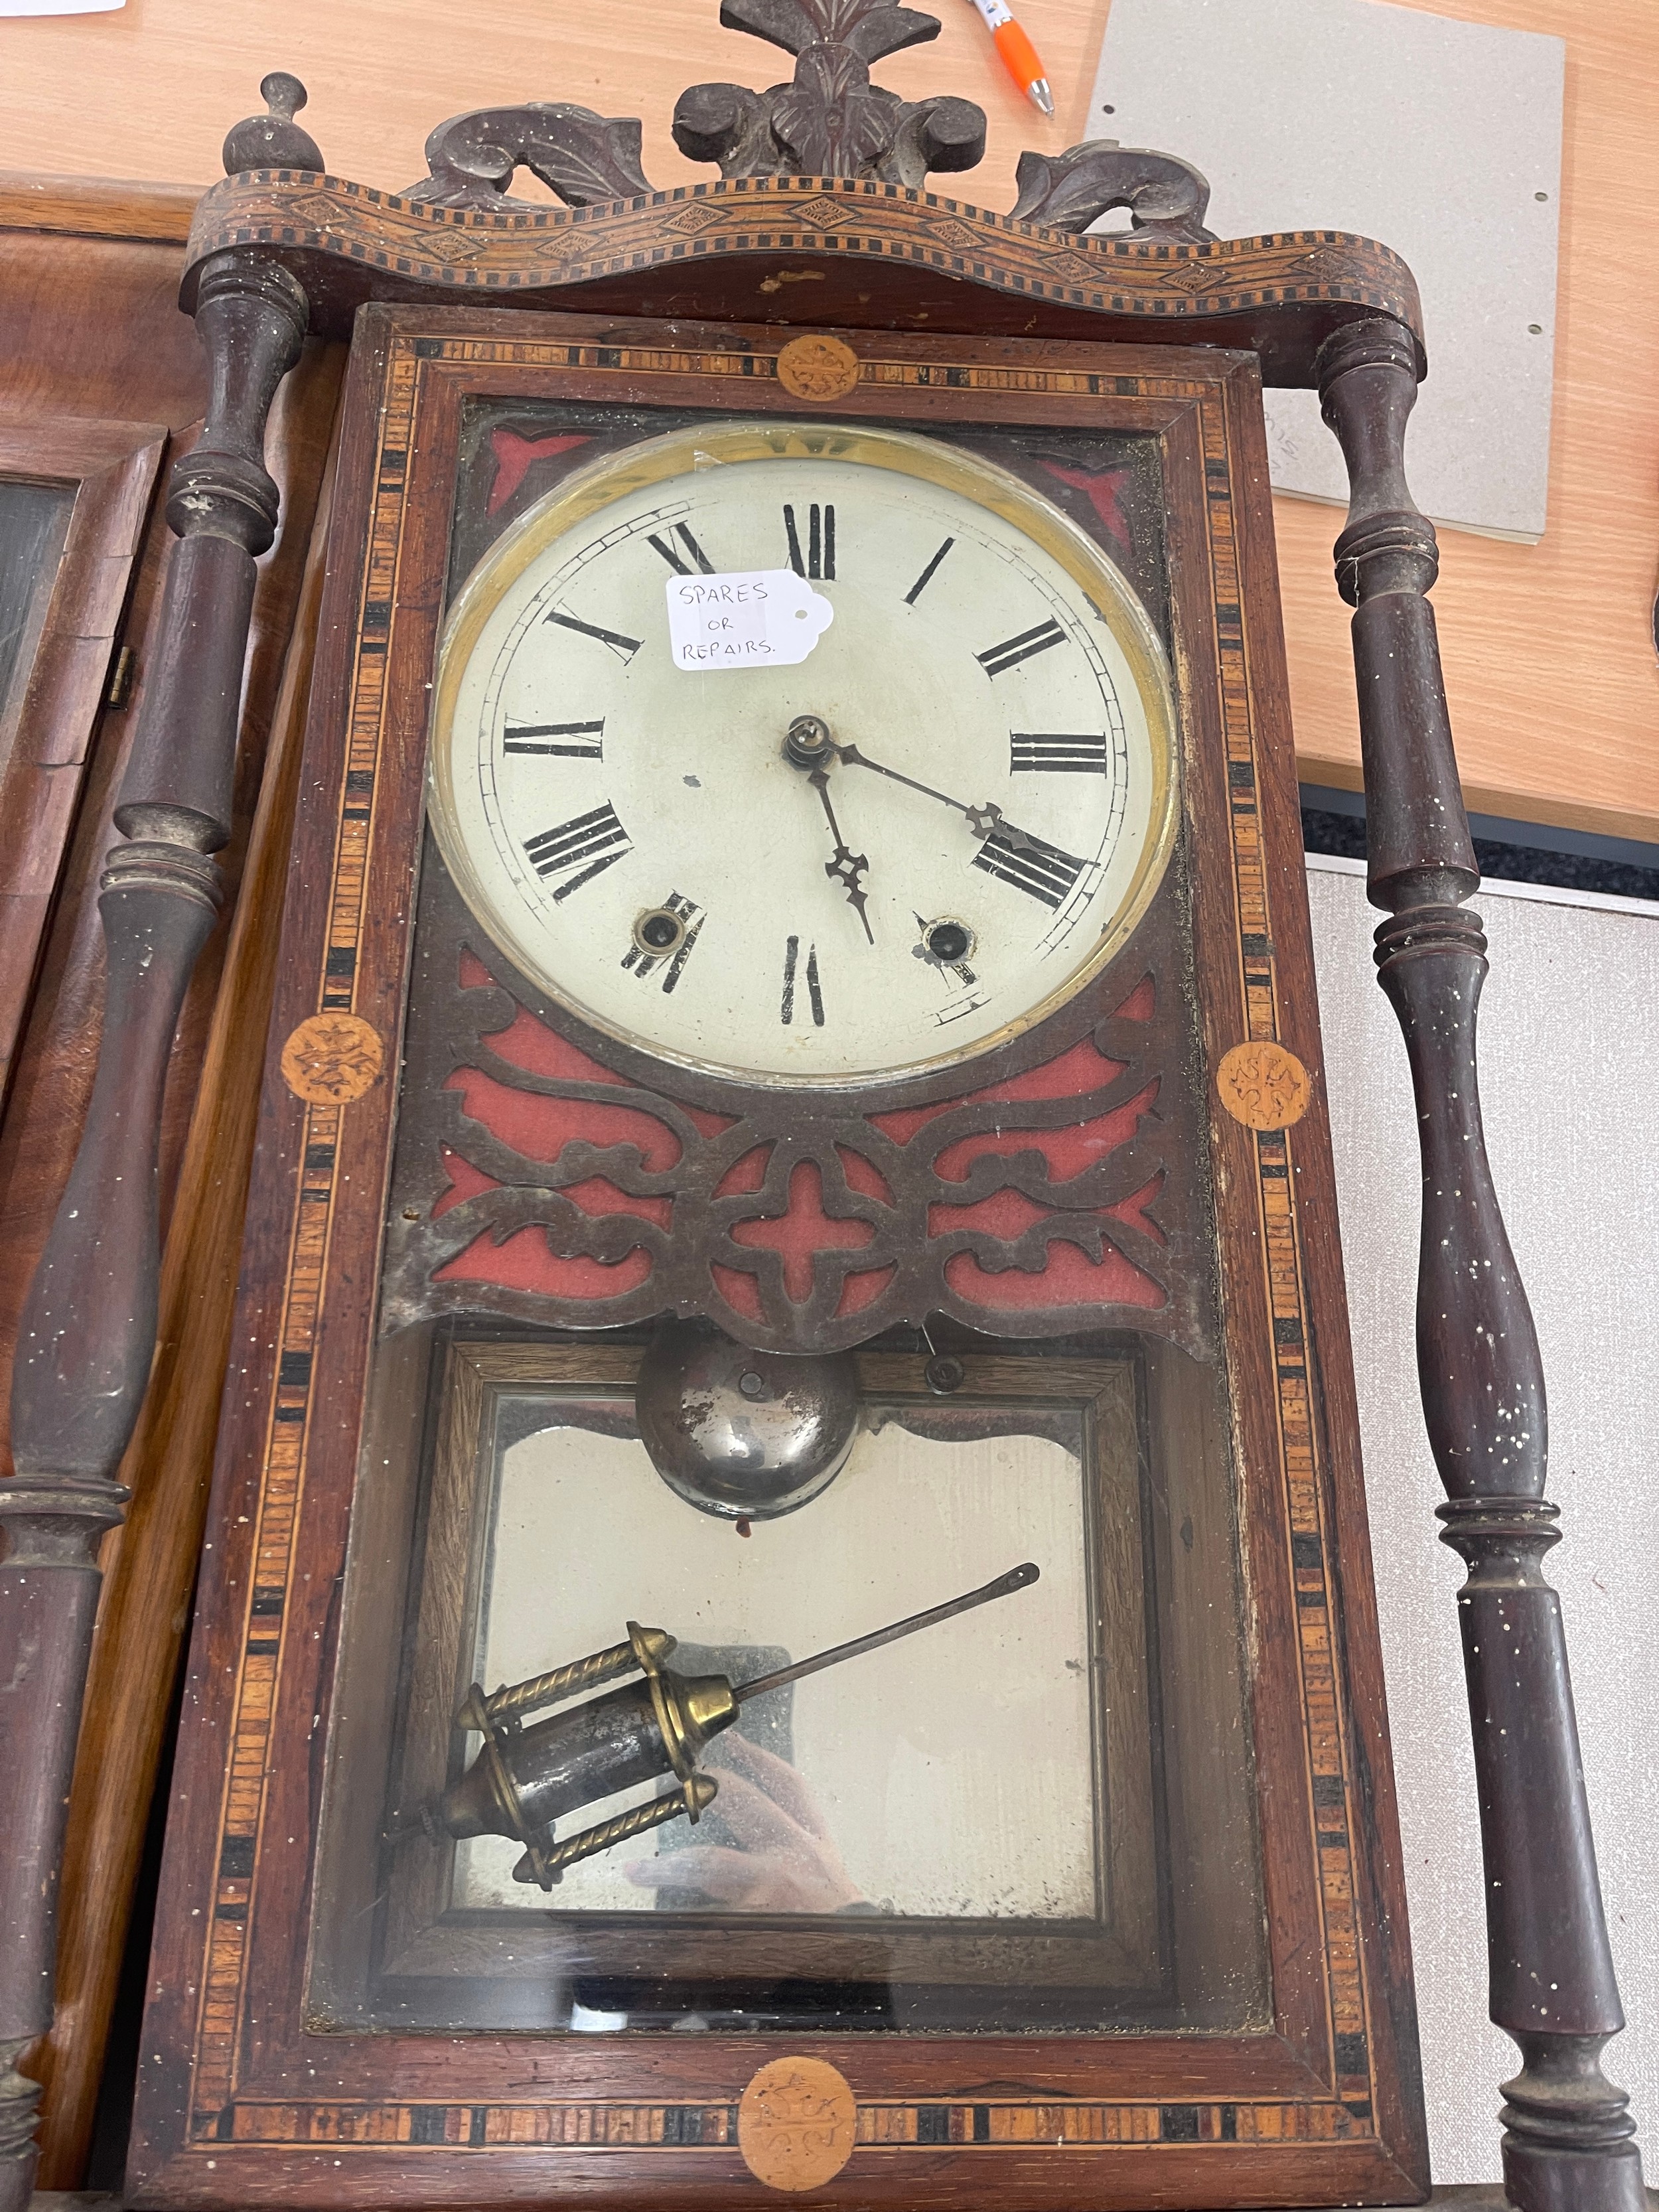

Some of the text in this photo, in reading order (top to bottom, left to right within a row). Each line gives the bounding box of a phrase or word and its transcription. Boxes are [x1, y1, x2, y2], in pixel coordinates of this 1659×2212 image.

[780, 503, 839, 581] XII
[680, 583, 768, 605] SPARES
[900, 536, 956, 607] I
[541, 598, 646, 666] X
[683, 640, 776, 660] REPAIRS.
[707, 617, 734, 630] OR
[972, 615, 1070, 681] II
[503, 712, 606, 763] IX
[1009, 729, 1107, 779] III
[520, 798, 635, 905] VIII
